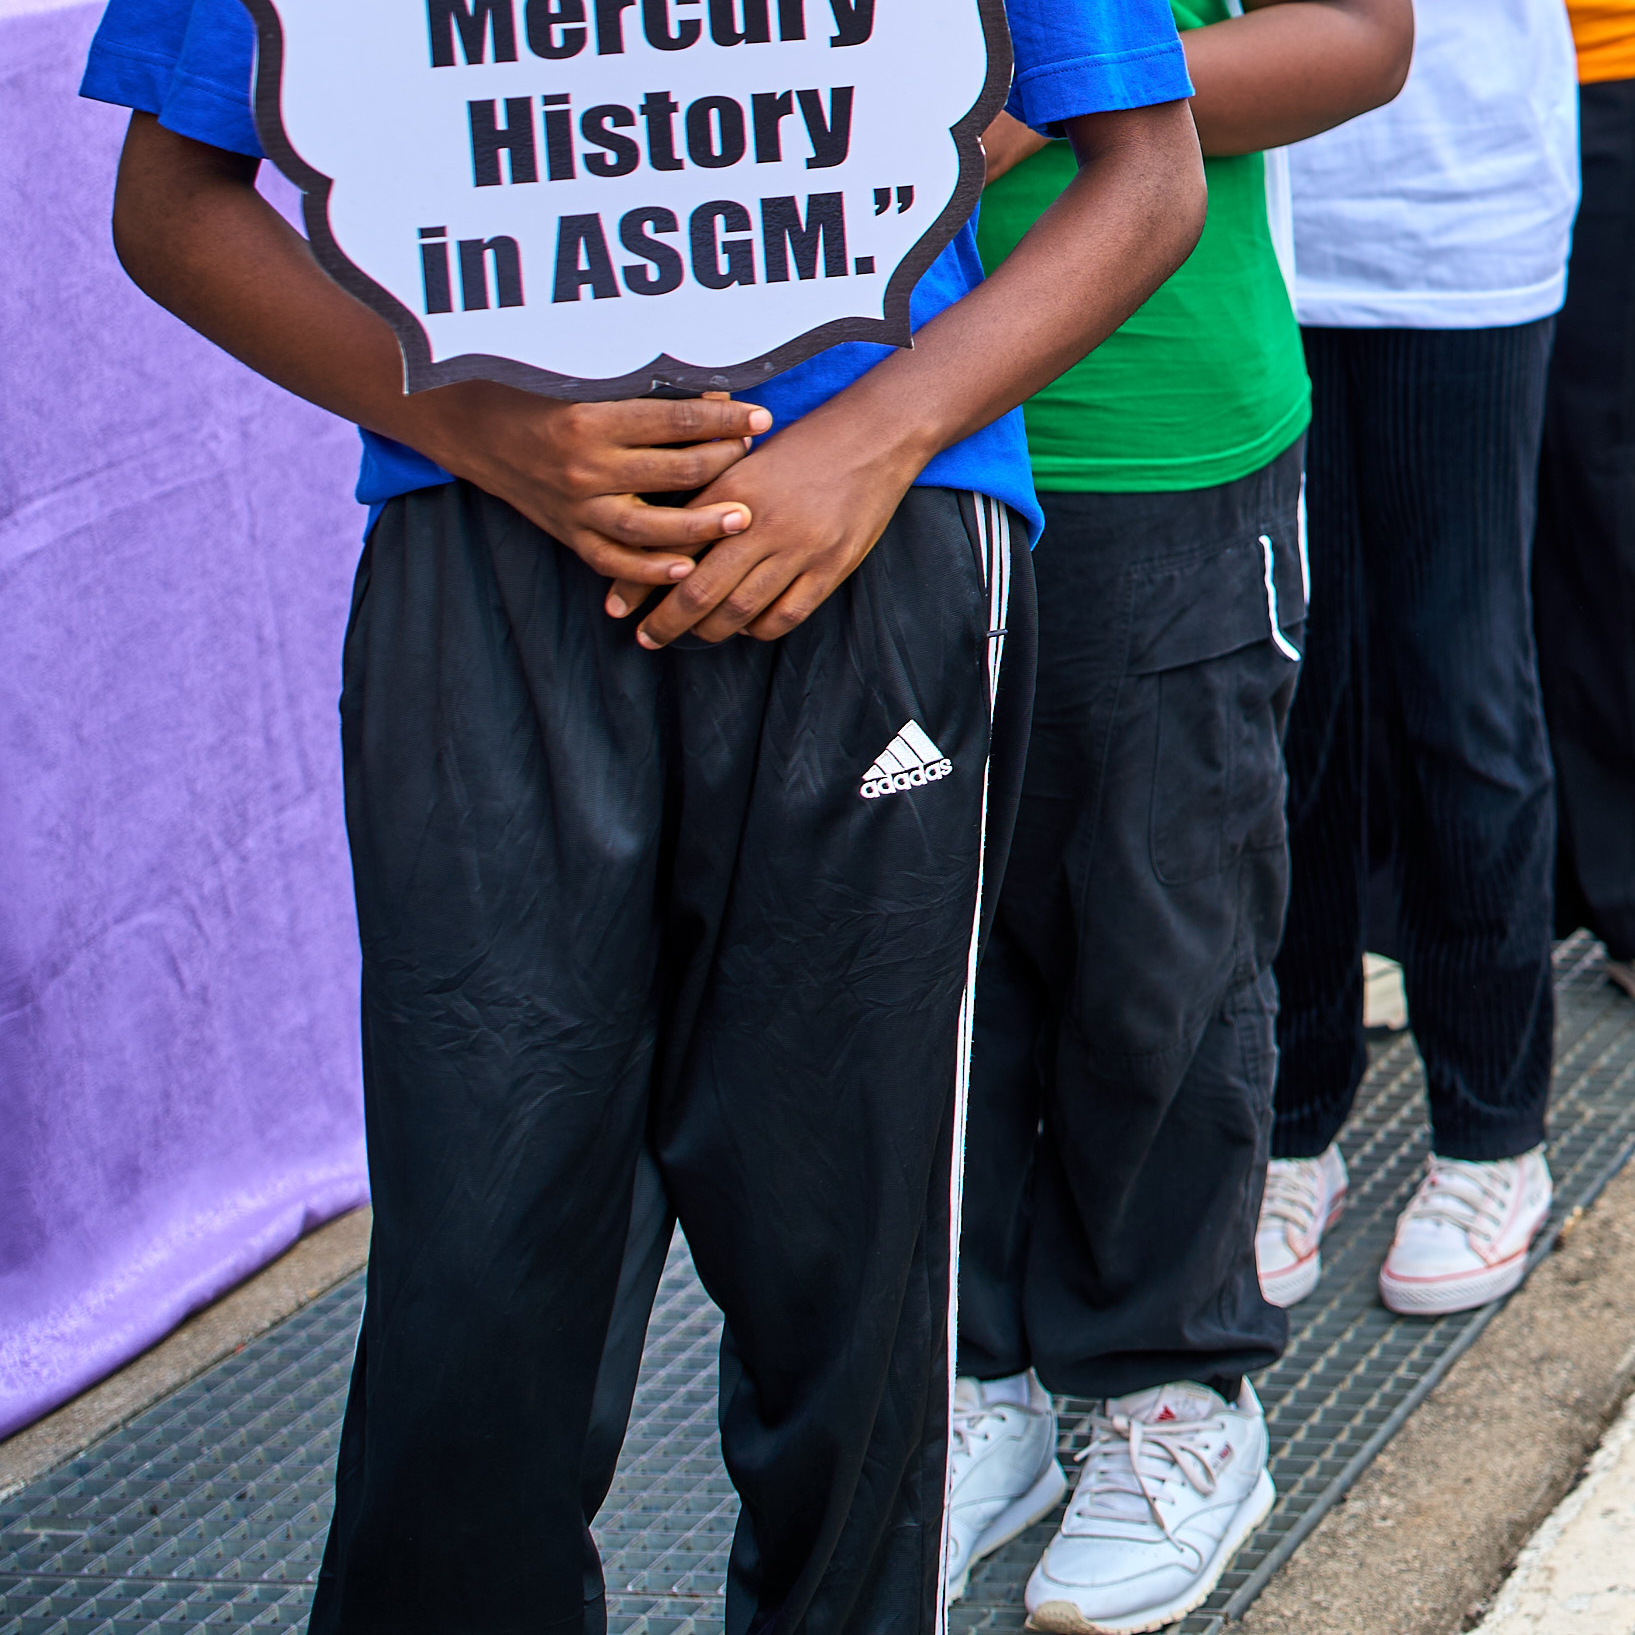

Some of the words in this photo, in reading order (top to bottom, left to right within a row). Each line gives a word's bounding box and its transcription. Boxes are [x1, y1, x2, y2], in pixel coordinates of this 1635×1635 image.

[466, 85, 856, 189] History
[417, 226, 526, 316] in
[860, 758, 953, 799] adidas
